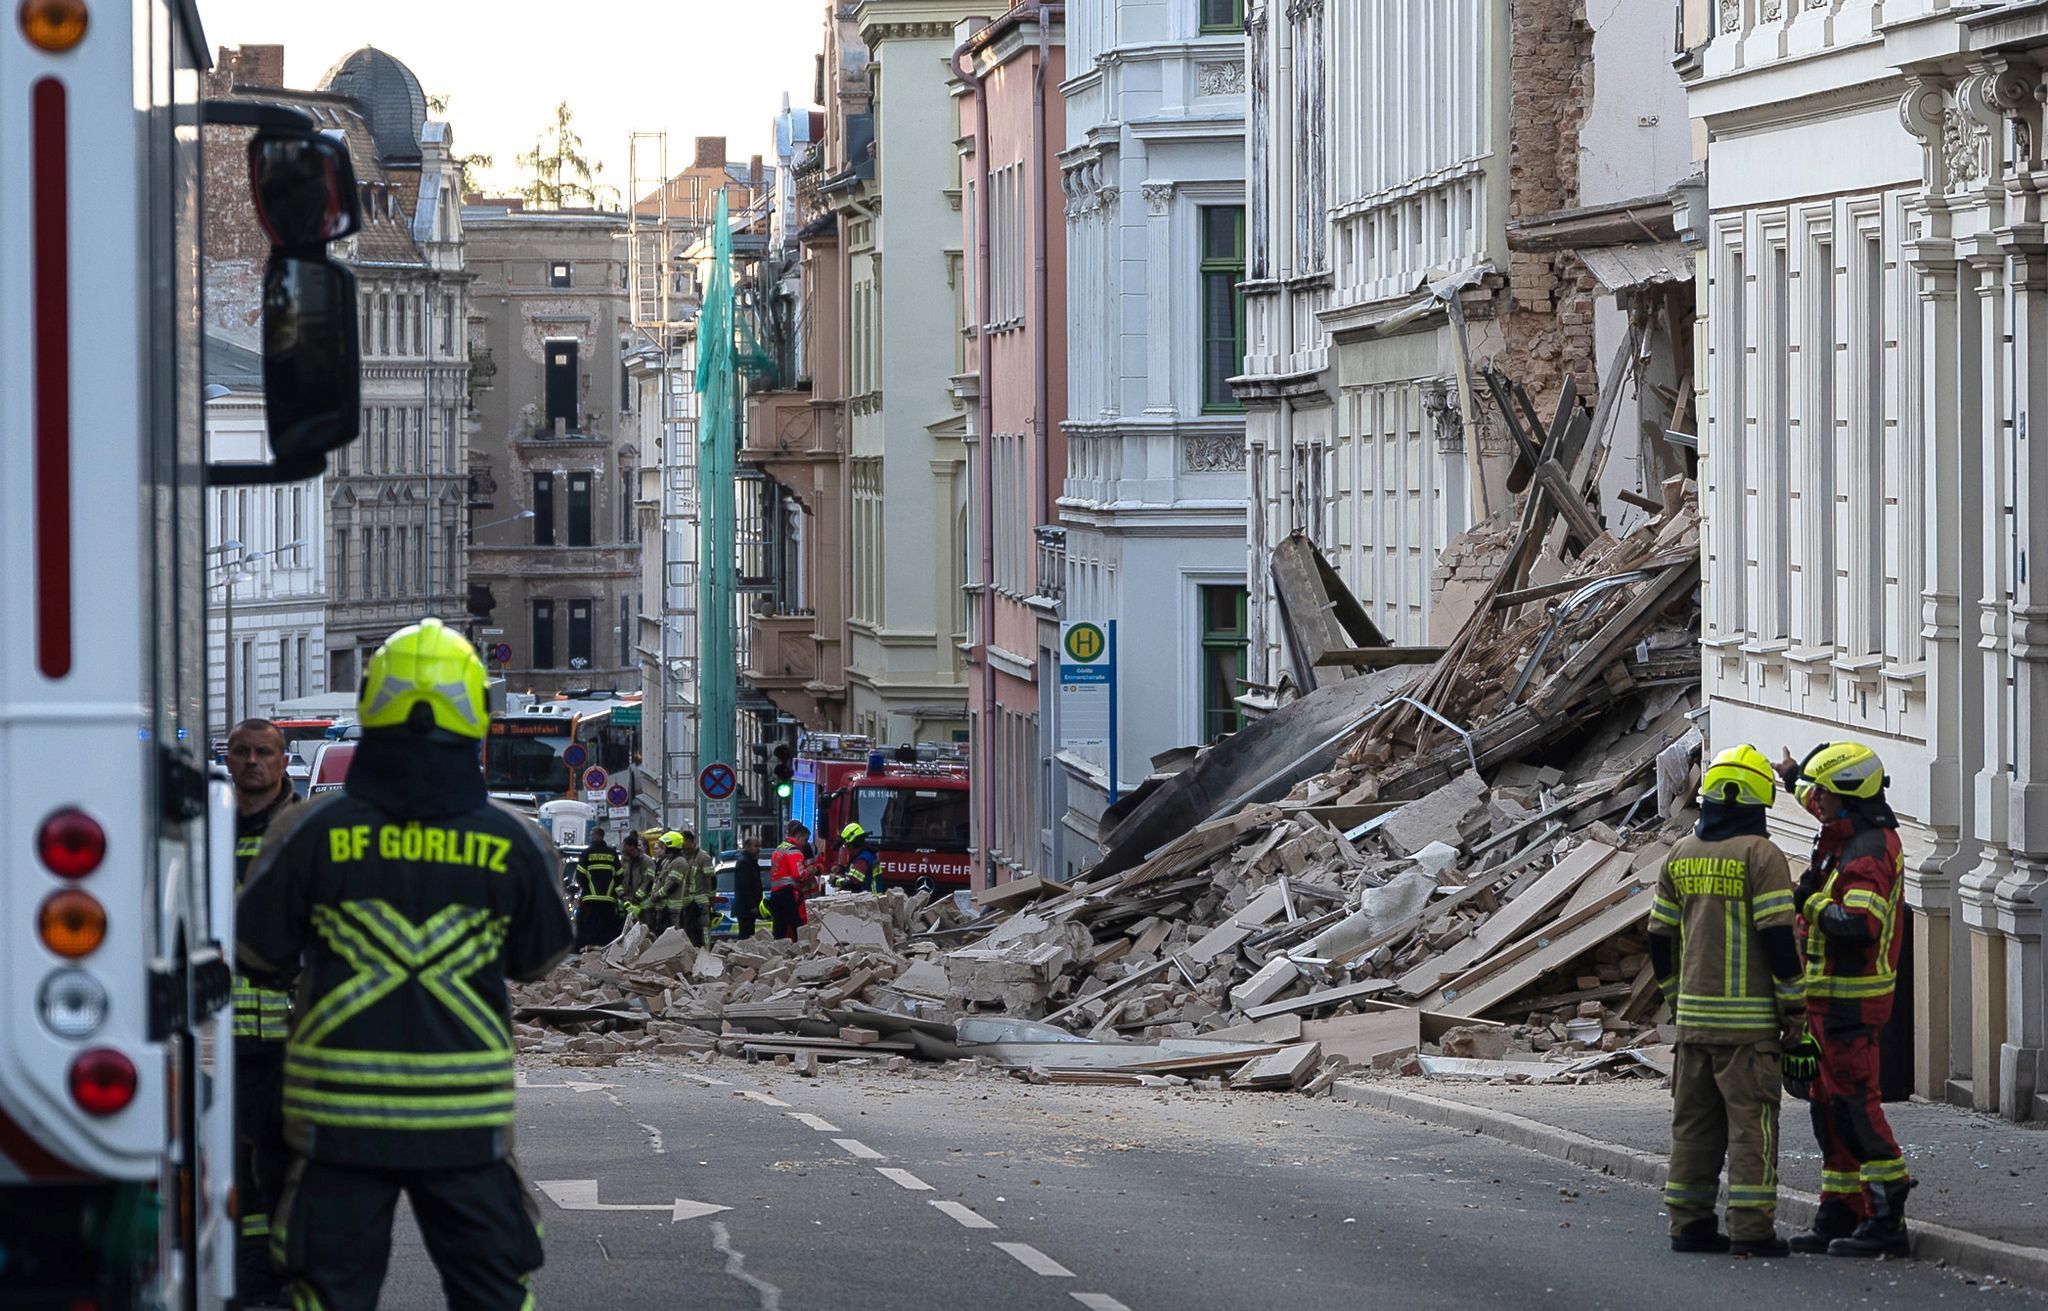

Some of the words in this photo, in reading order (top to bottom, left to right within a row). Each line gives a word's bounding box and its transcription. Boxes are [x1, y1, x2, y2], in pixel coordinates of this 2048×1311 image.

[1076, 631, 1093, 654] H
[329, 825, 371, 862] BF
[379, 820, 512, 873] GÖRLITZ
[880, 862, 971, 875] FEUERWEHR
